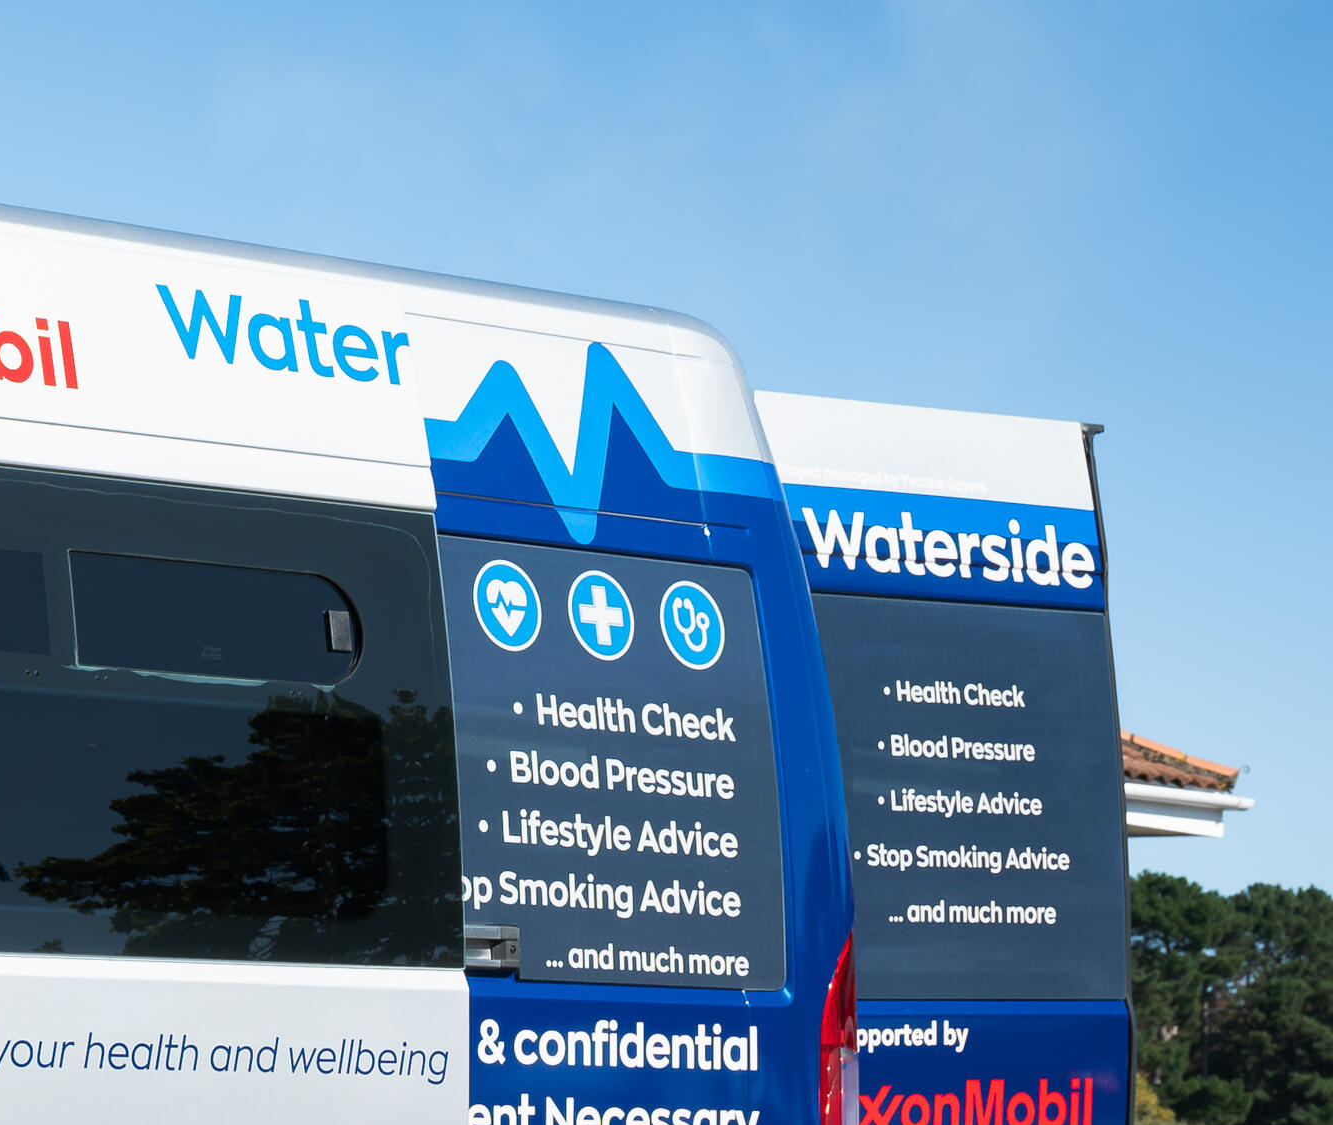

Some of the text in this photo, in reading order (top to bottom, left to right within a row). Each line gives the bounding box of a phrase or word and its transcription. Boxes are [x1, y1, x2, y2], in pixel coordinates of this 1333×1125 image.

[157, 285, 409, 384] Water
[801, 508, 1095, 588] Waterside
[896, 680, 1025, 707] Health Check
[536, 694, 736, 741] Health Check
[891, 734, 1035, 761] Blood Pressure
[510, 751, 734, 799] Blood Pressure
[891, 789, 1042, 817] Lifestyle Advice
[503, 809, 738, 858] Lifestyle Advice
[867, 844, 1070, 873] Stop Smoking Advice
[462, 871, 741, 918] op Smoking Advice
[907, 900, 944, 922] and
[949, 901, 1002, 923] much
[1007, 906, 1056, 924] more
[568, 943, 613, 970] and
[619, 947, 683, 973] much
[689, 954, 749, 976] more
[84, 1032, 198, 1071] health
[211, 1037, 279, 1072] and
[290, 1039, 448, 1084] wellbeing
[478, 1019, 757, 1071] & confidential
[857, 1020, 968, 1053] pported by
